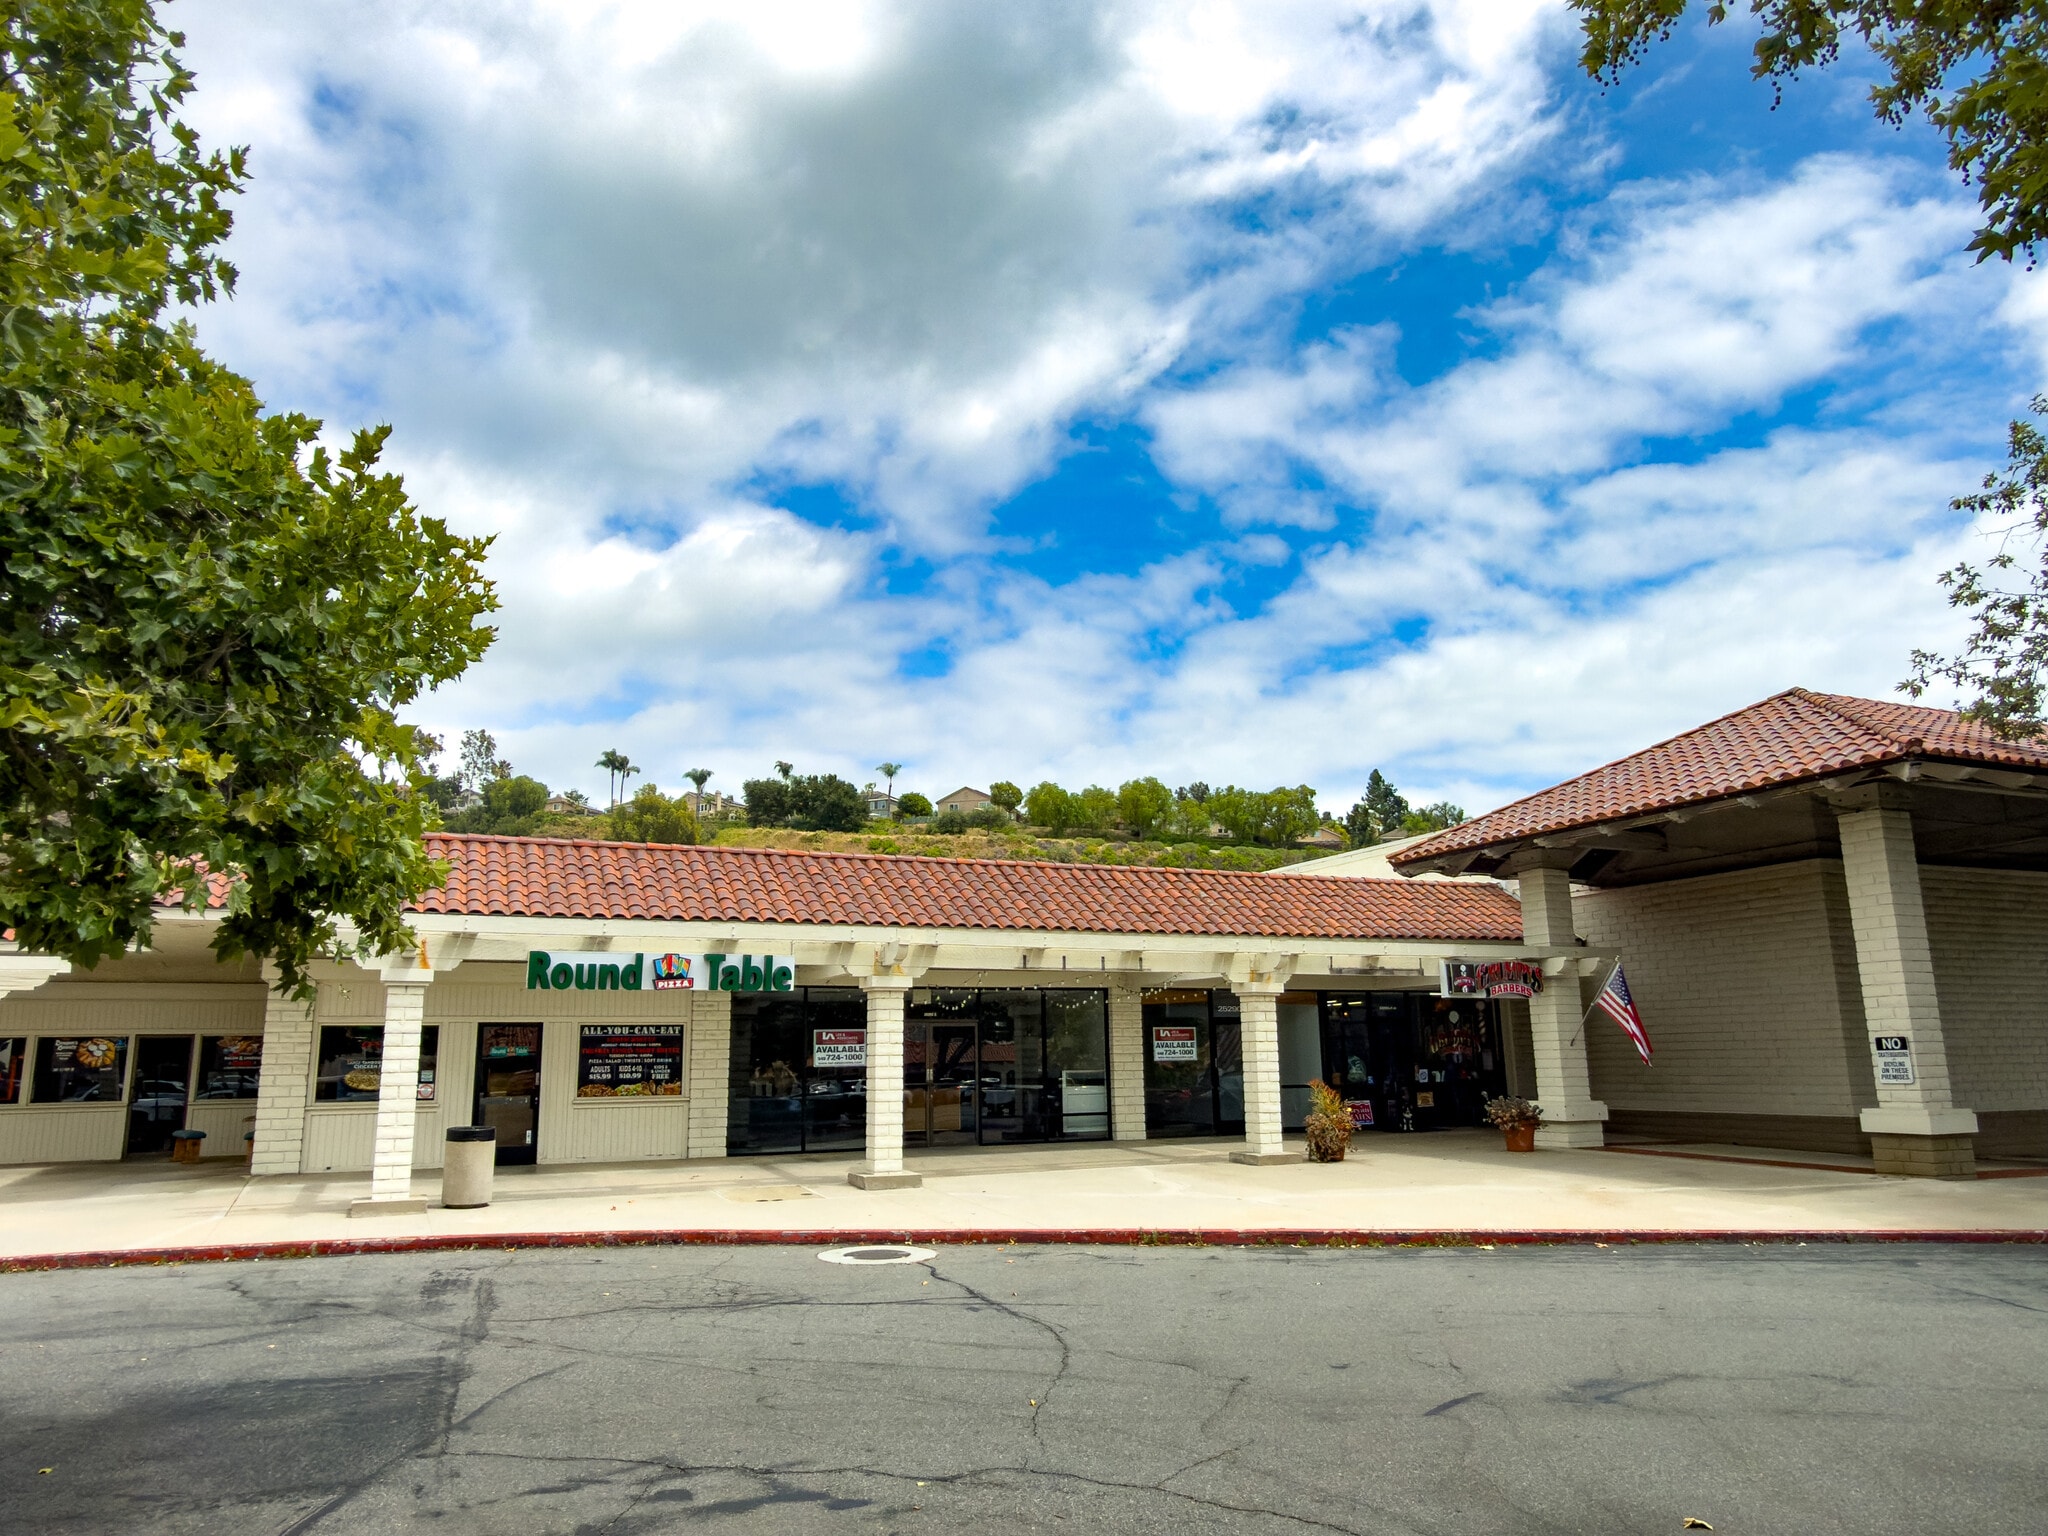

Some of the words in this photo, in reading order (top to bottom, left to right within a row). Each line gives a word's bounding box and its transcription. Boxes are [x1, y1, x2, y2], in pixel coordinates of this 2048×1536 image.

[527, 950, 644, 990] Round
[703, 953, 793, 992] Table
[657, 979, 691, 989] PIZZA
[1490, 983, 1534, 998] BARBERS
[582, 1026, 681, 1035] ALL-YOU-CAN-EAT
[1881, 1037, 1902, 1049] NO
[590, 1065, 611, 1073] ADULTS
